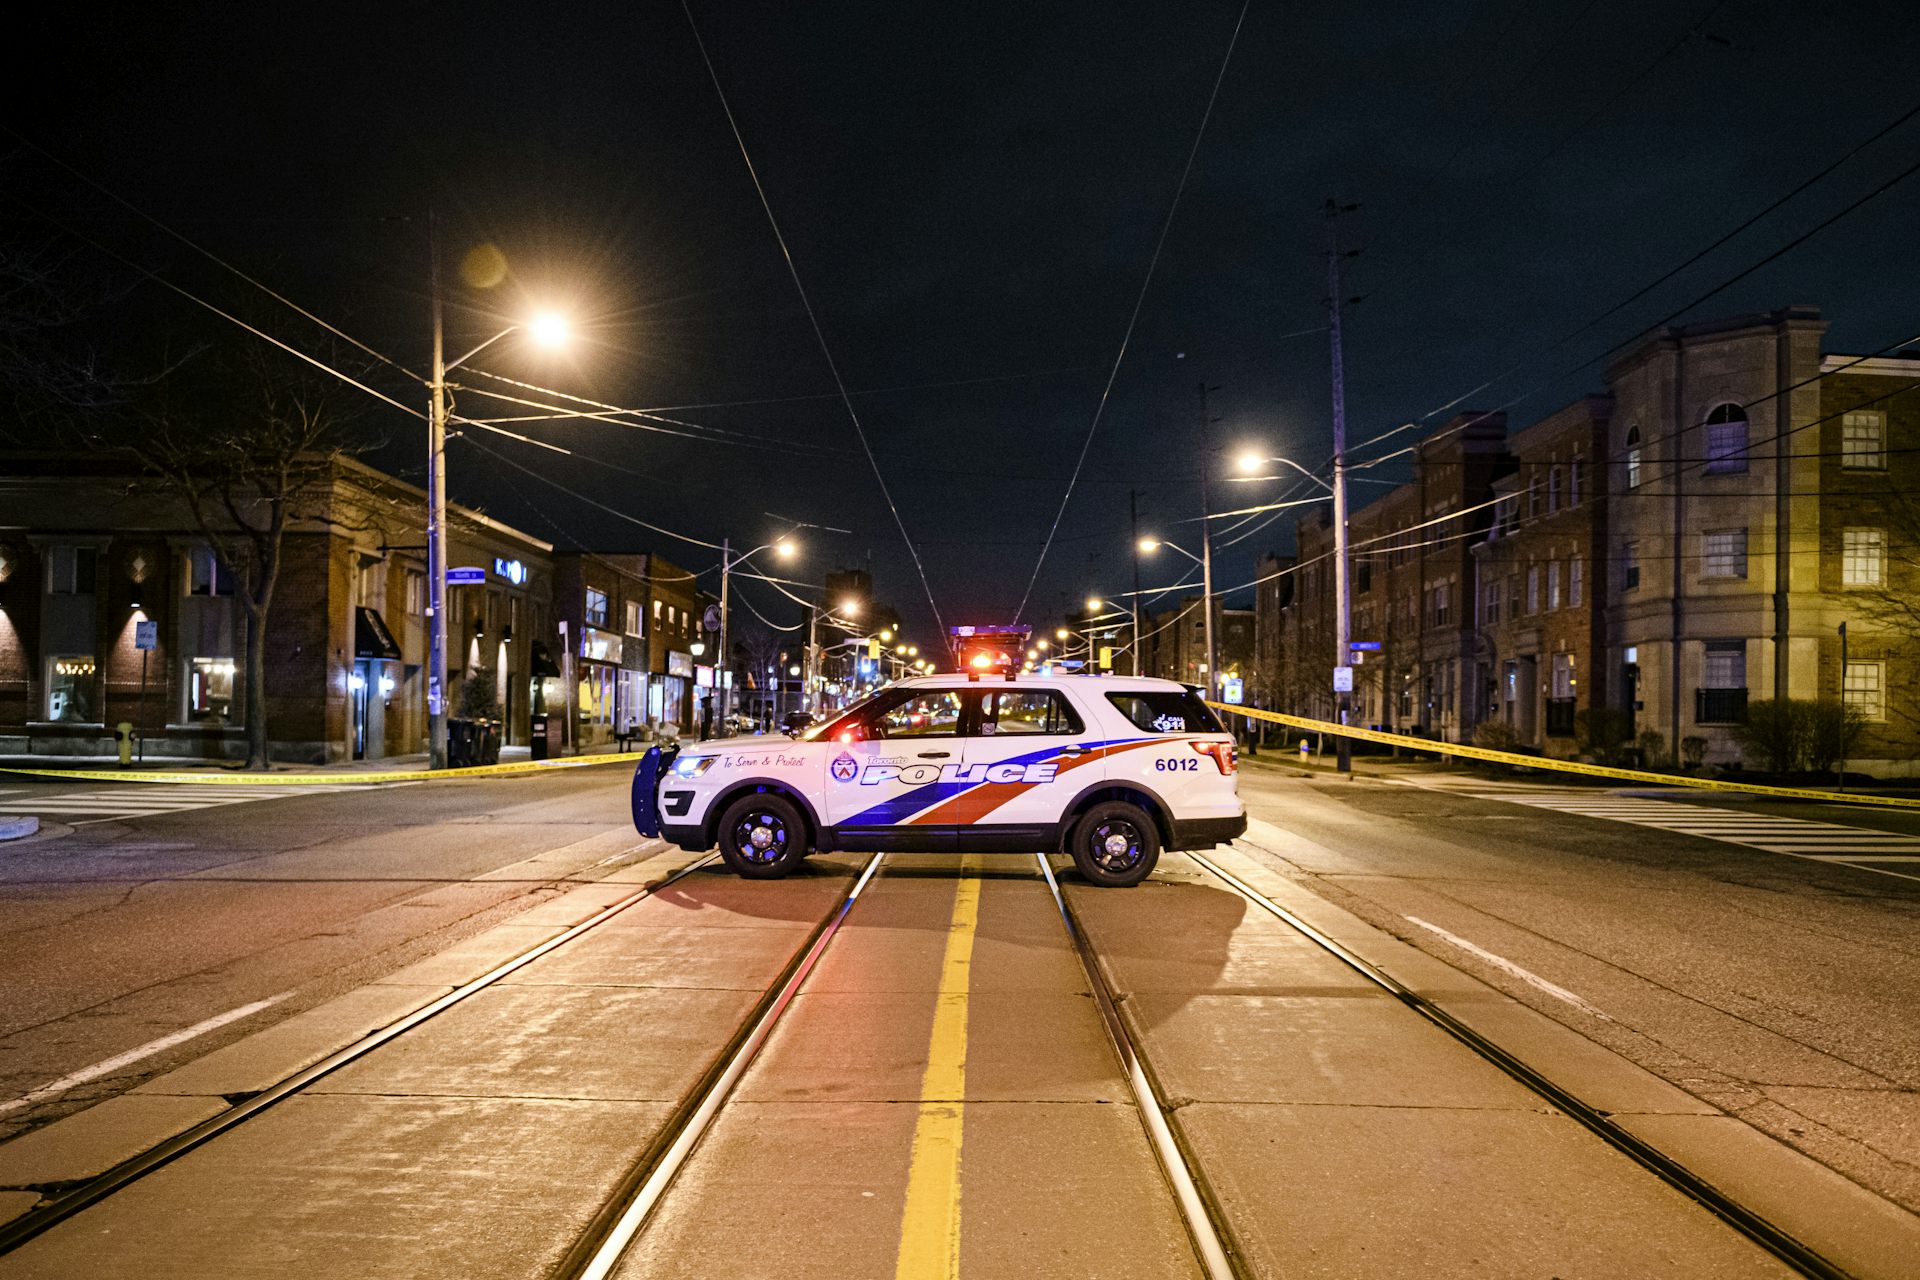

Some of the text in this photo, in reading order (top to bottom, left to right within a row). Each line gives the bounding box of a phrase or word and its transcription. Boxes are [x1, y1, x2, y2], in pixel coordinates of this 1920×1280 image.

[1162, 720, 1185, 730] 911
[724, 754, 806, 768] To Serve & Protect
[867, 755, 908, 764] Toronto
[1155, 758, 1198, 771] 6012
[860, 764, 1059, 785] POLICE
